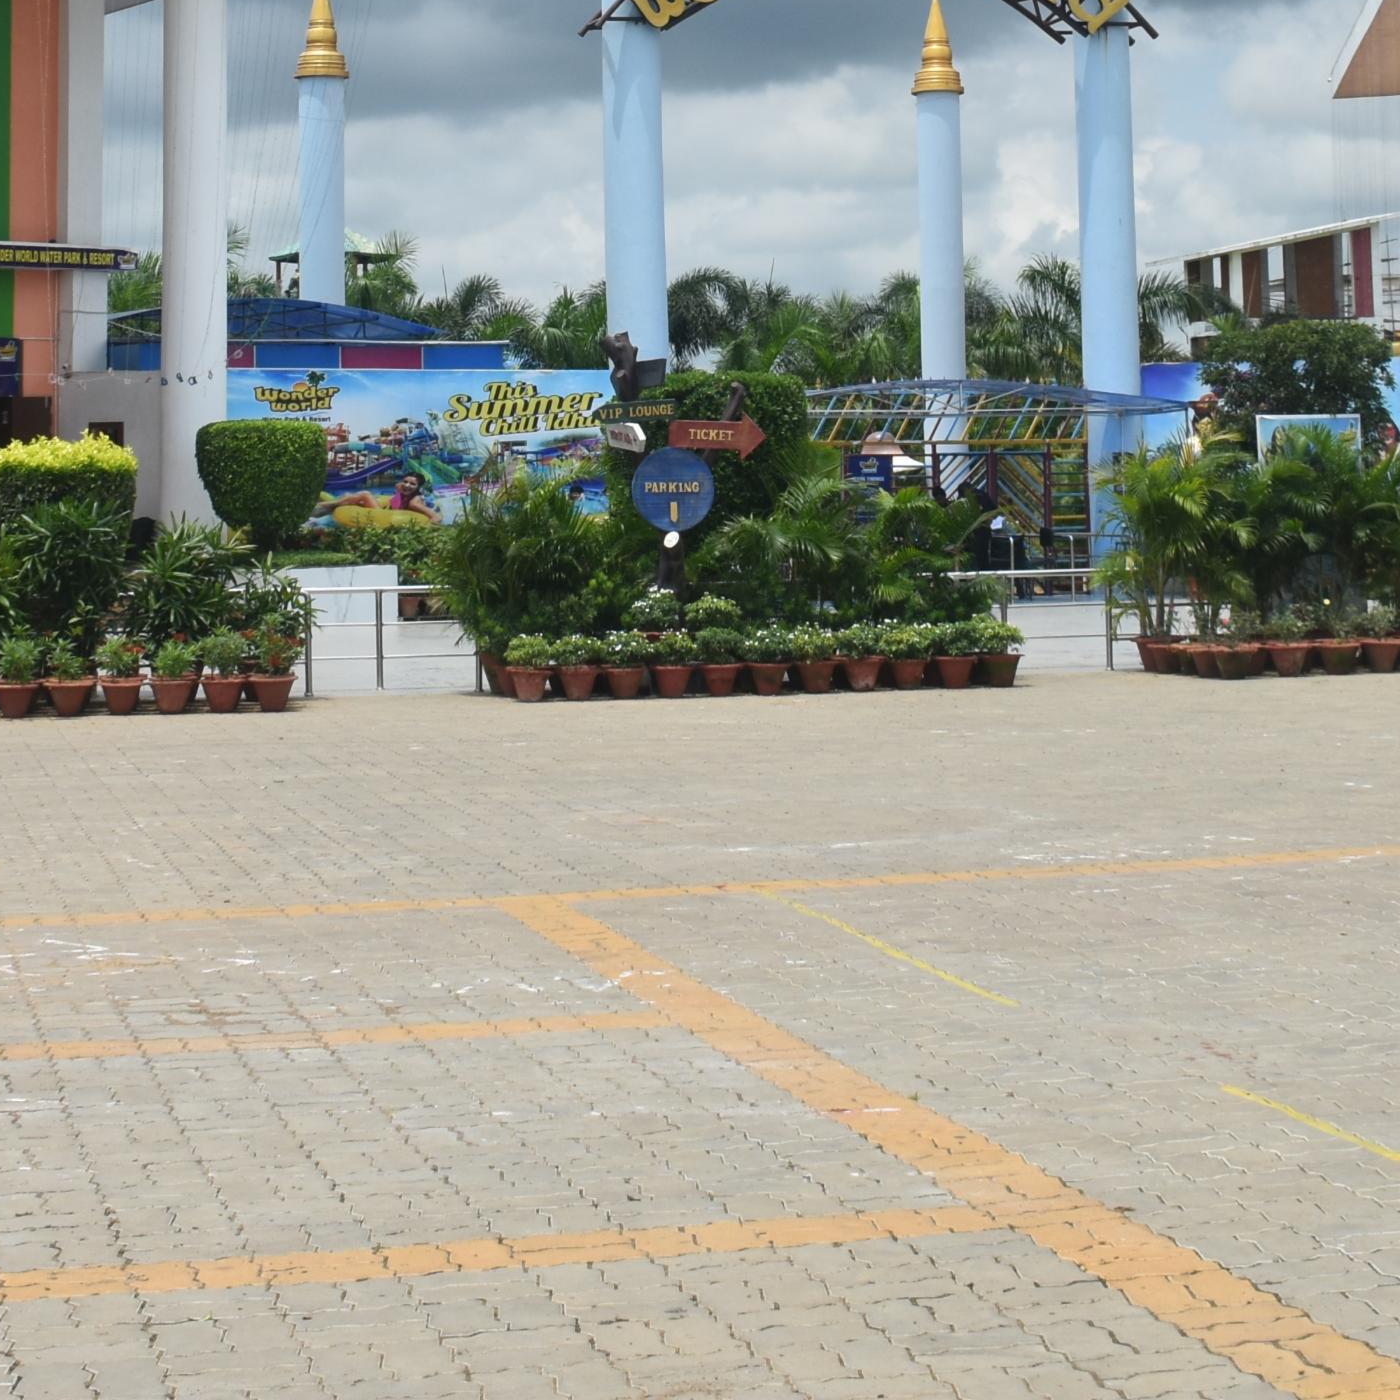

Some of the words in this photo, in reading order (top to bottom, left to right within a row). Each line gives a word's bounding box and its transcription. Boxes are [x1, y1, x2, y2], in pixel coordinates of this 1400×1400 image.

[15, 250, 38, 263] WORLD
[40, 251, 63, 264] WATER
[64, 252, 81, 264] PARK
[89, 252, 115, 265] RESORT
[254, 386, 340, 401] Wonder
[483, 380, 538, 401] This
[270, 396, 332, 412] world
[443, 392, 603, 423] Summer
[600, 407, 623, 420] VIP
[629, 403, 675, 418] LOUNGE
[479, 414, 541, 437] Chill
[688, 428, 735, 441] TICKET
[644, 481, 700, 494] PARKING
